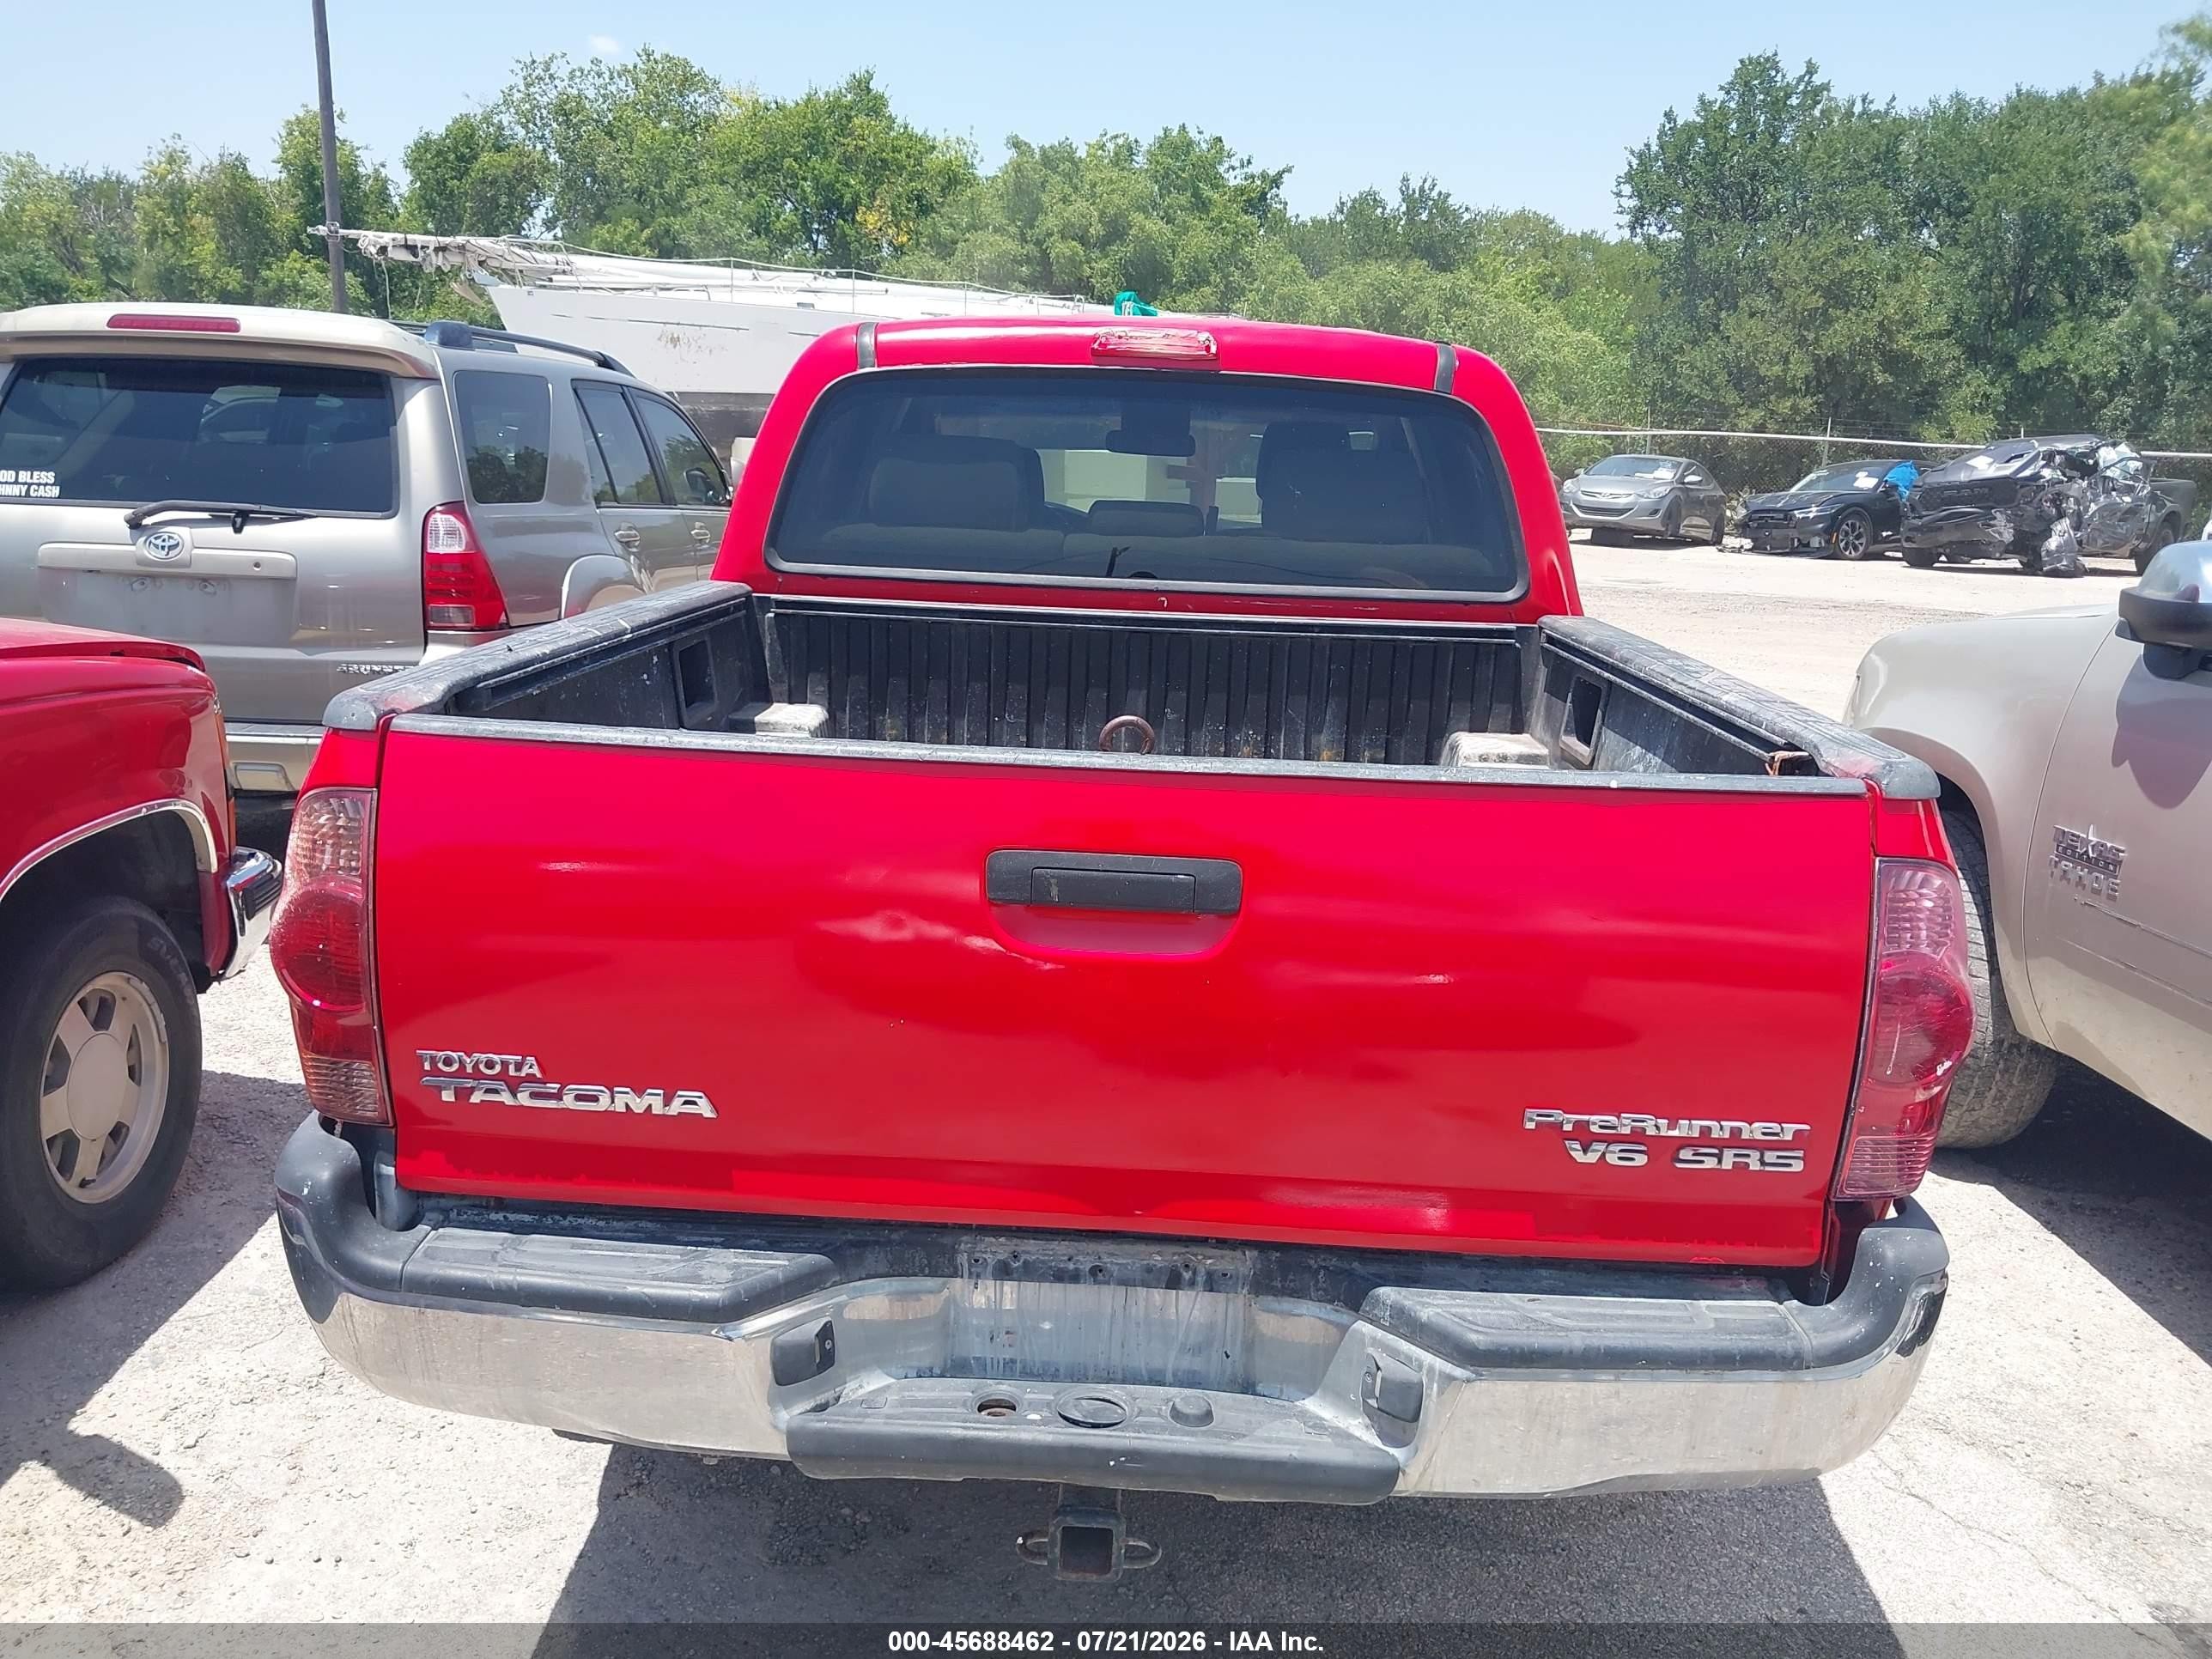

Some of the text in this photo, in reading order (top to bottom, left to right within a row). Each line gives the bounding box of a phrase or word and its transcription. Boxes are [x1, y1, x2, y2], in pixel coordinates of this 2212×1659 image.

[0, 470, 55, 484] OD BLESS
[0, 483, 60, 498] HNNY CASH
[2053, 824, 2128, 861] TEXAS
[2057, 846, 2114, 872] EDITION
[2048, 855, 2122, 897] TAHOE
[416, 1049, 544, 1079] TOYOTA
[420, 1076, 719, 1119] TACOMA
[1523, 1108, 1812, 1141] PreRunner
[1563, 1139, 1804, 1172] V6 SR5
